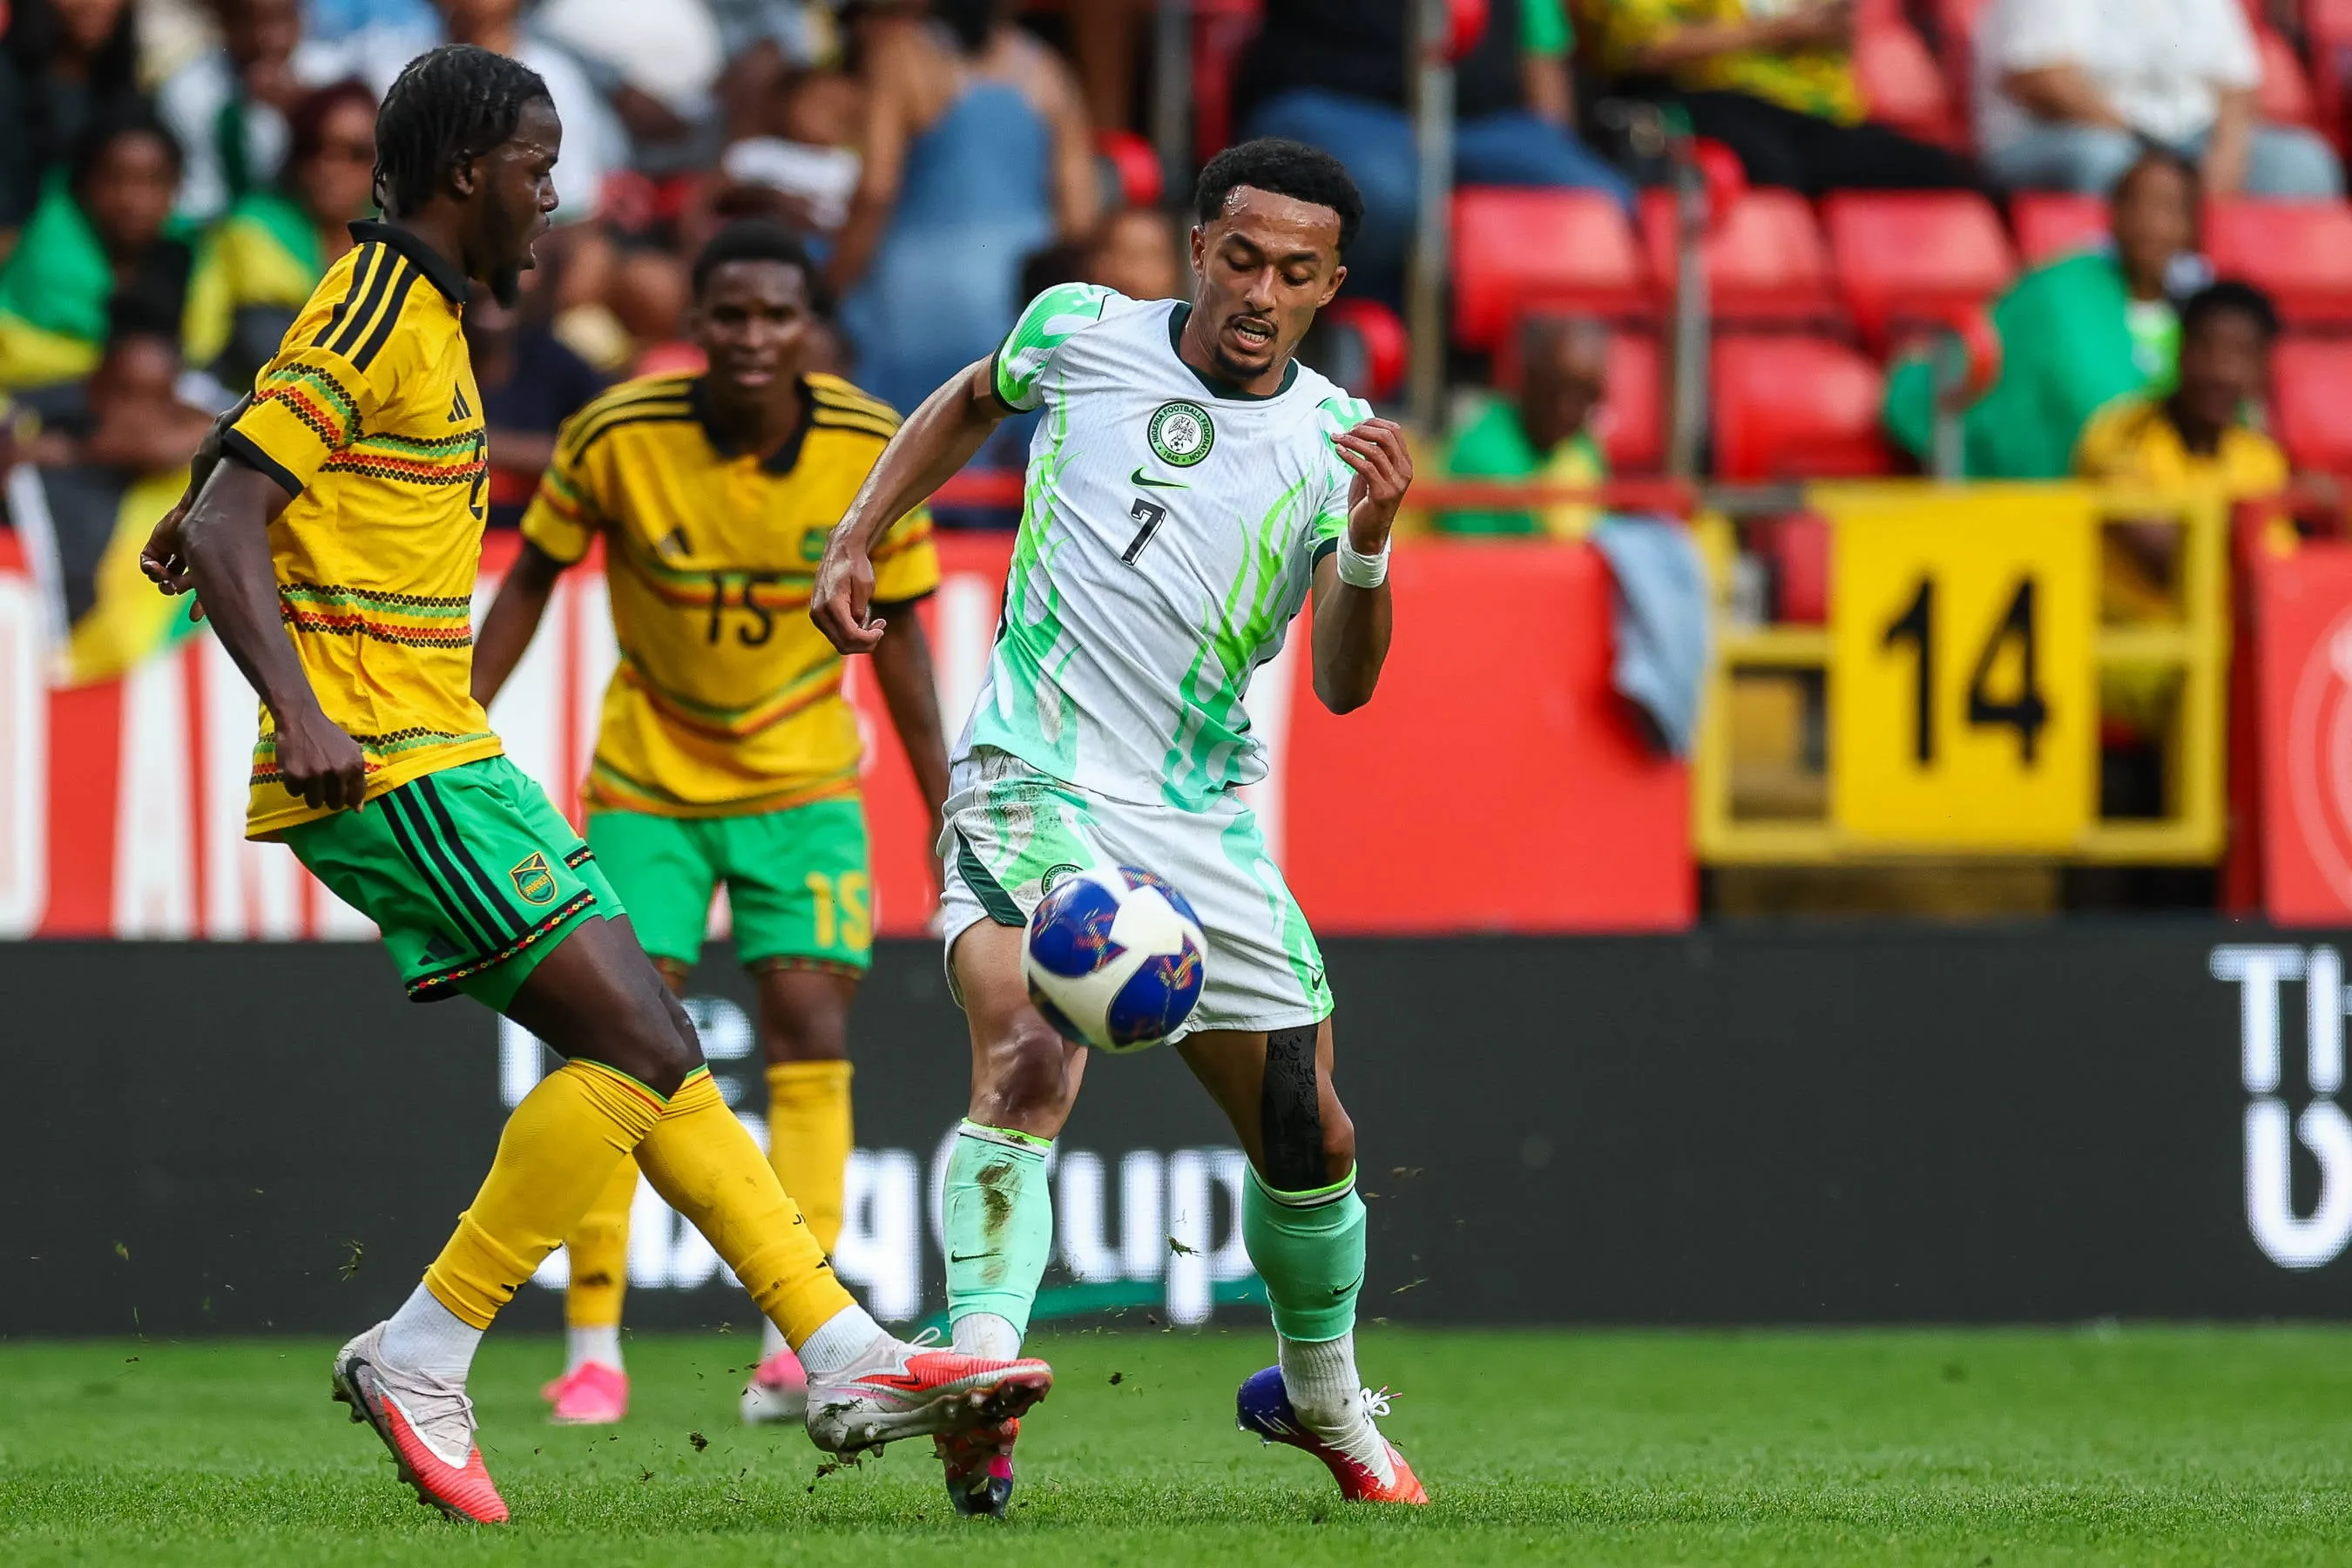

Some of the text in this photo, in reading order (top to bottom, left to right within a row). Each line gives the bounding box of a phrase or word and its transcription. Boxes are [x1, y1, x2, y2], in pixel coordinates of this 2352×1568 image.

[1151, 405, 1211, 462] NIGERIA FOOTBALL FEDERATION
[1163, 450, 1179, 463] 1945
[1121, 498, 1166, 566] 7
[709, 571, 778, 645] 15
[1879, 571, 2050, 767] 14
[805, 870, 871, 952] 15
